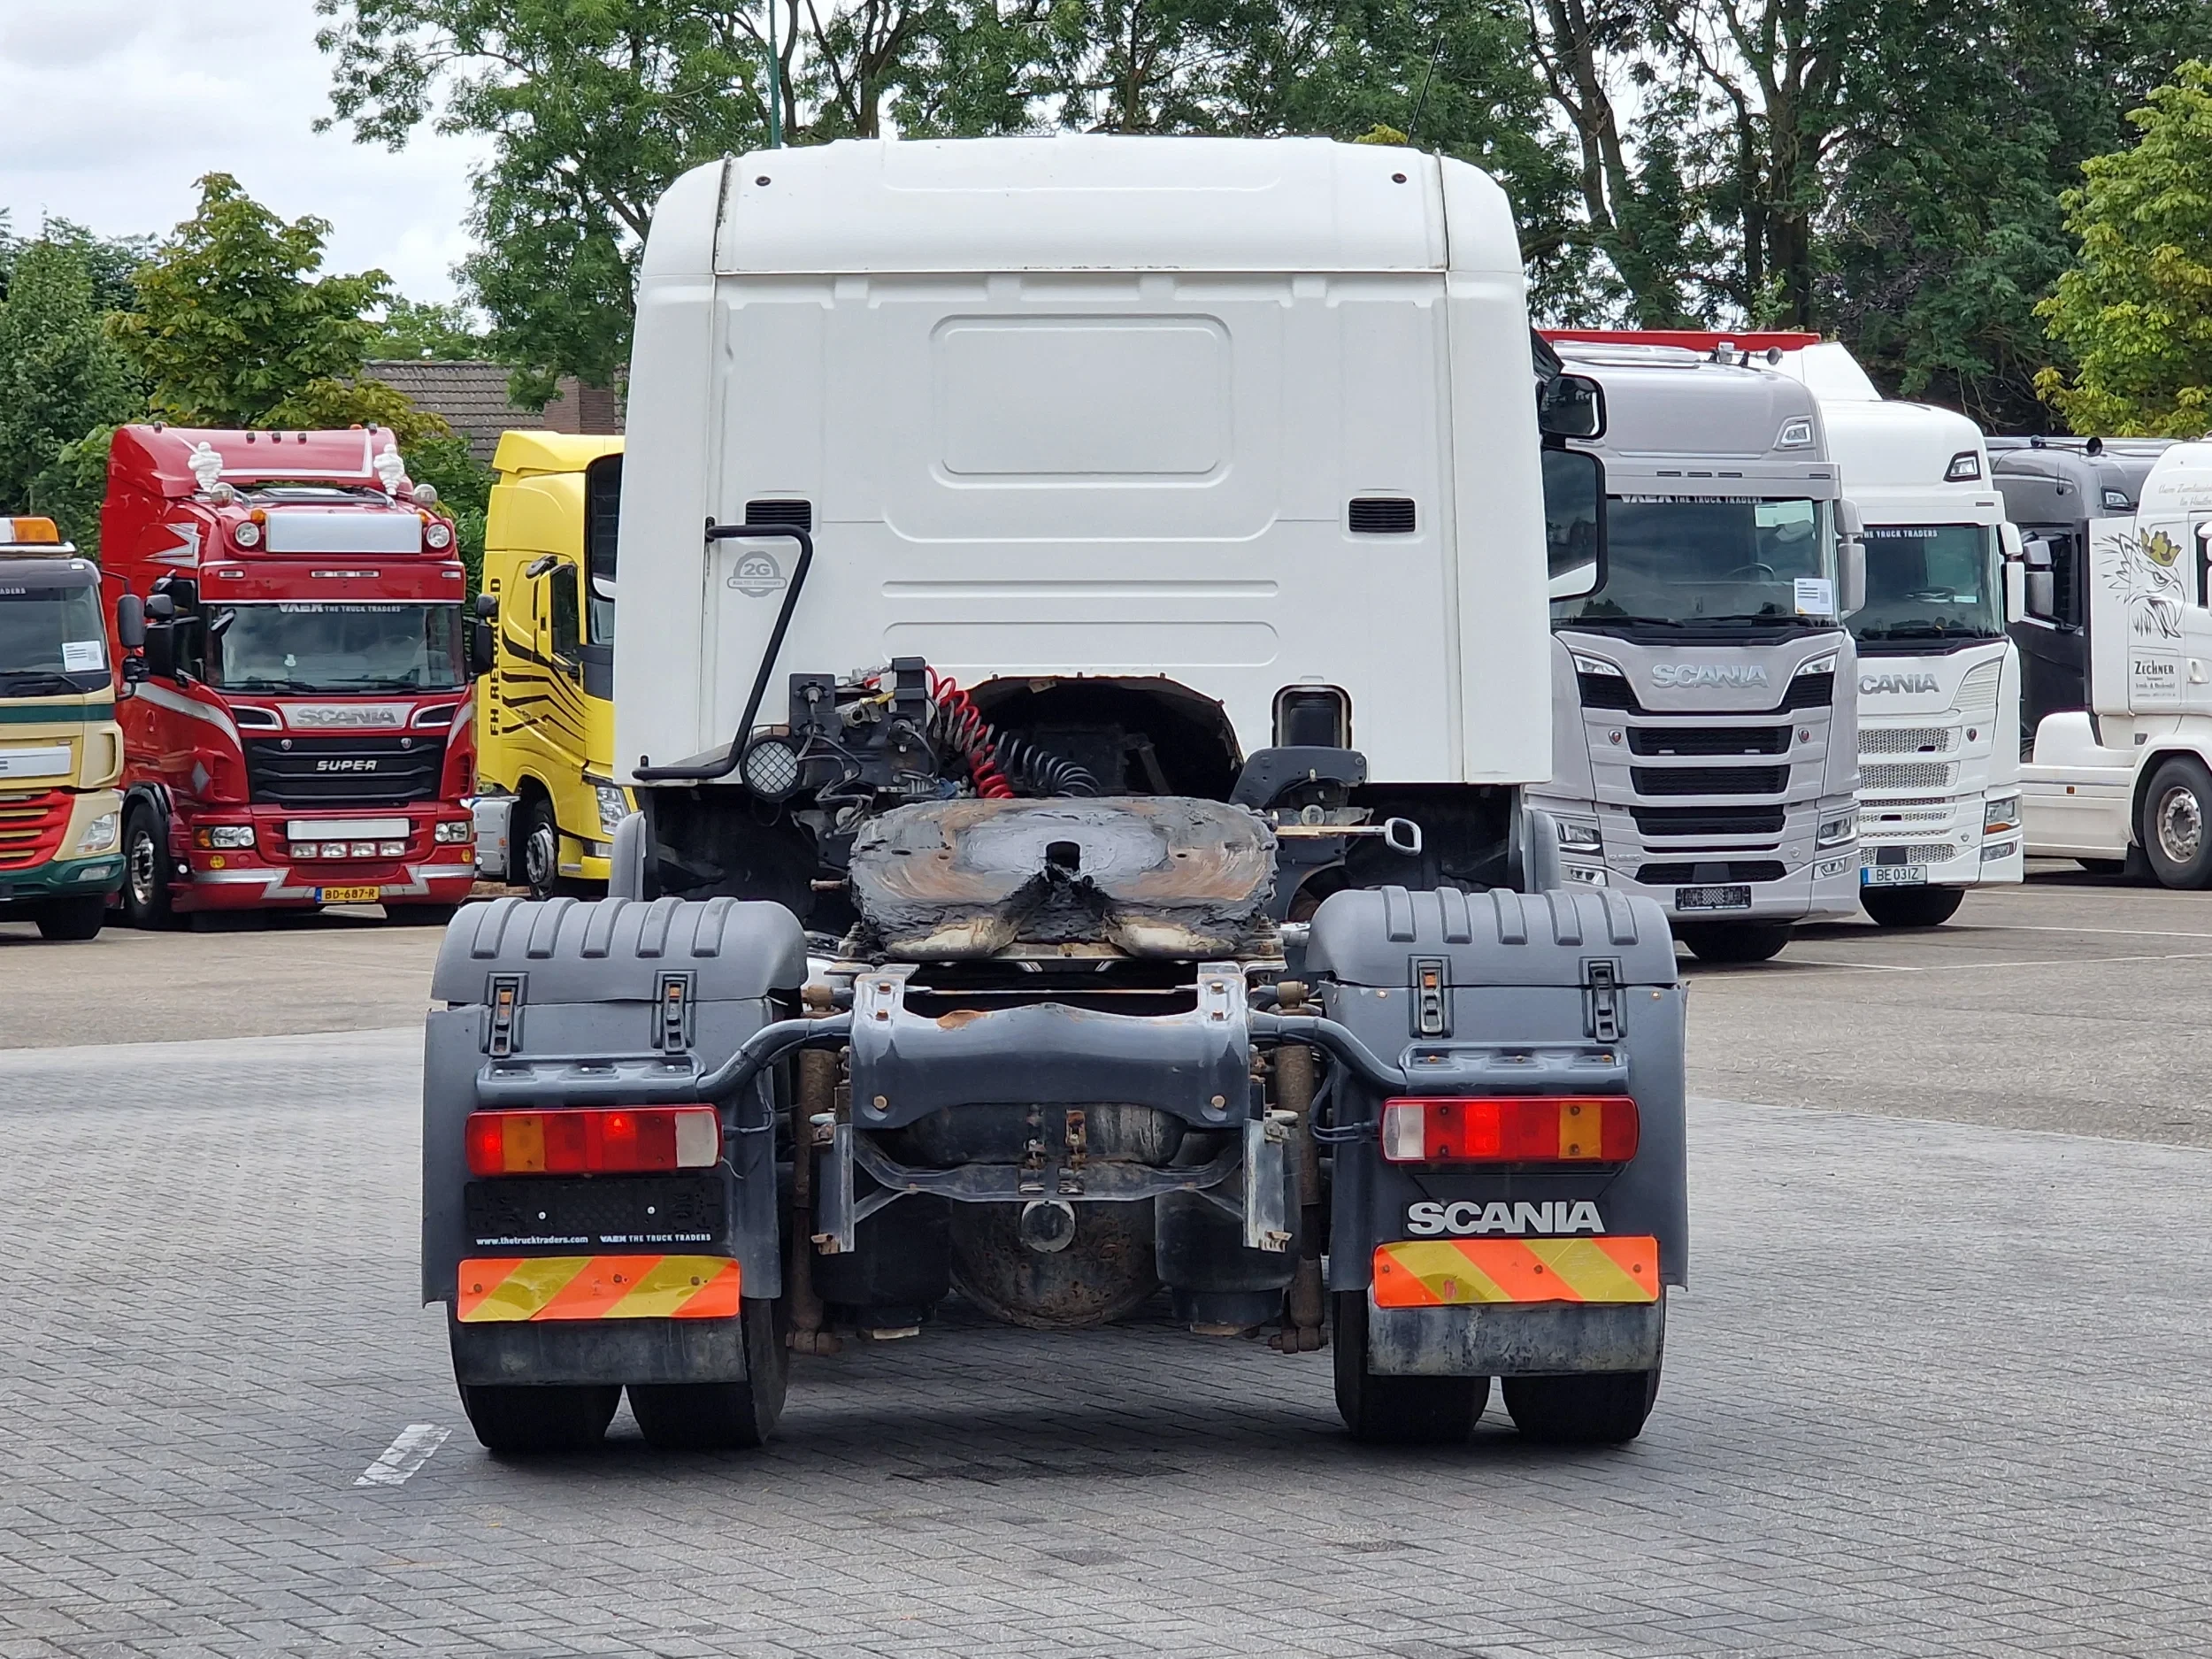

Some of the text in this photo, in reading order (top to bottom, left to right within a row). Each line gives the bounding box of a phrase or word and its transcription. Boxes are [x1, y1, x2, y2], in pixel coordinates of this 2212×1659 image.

[1903, 529, 1938, 538] TRADERS
[743, 563, 771, 576] 2G
[1651, 664, 1769, 688] SCANIA
[1858, 673, 1940, 695] CANIA
[296, 707, 396, 725] SCANIA
[489, 709, 499, 736] FH
[316, 759, 378, 772] SUPER
[1408, 1201, 1605, 1235] SCANIA
[476, 1234, 588, 1246] www.thetrucktraders.com
